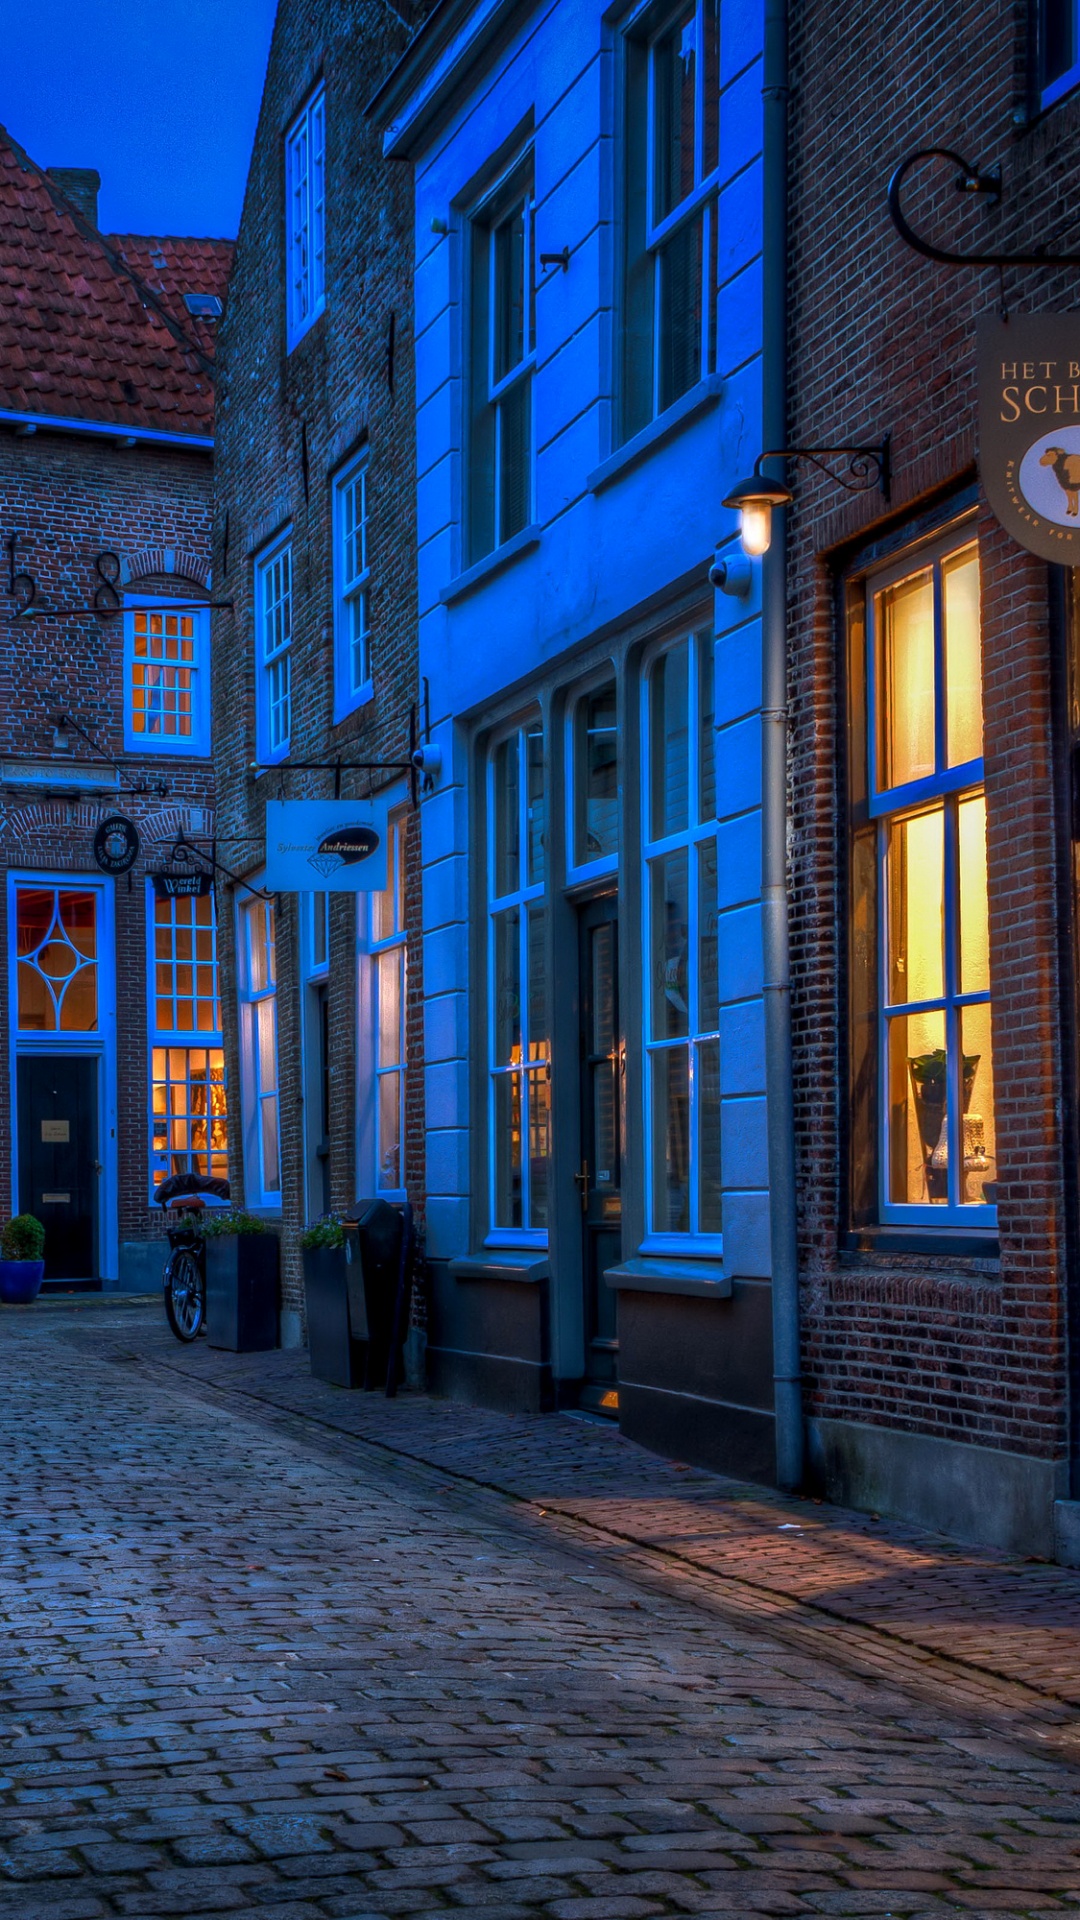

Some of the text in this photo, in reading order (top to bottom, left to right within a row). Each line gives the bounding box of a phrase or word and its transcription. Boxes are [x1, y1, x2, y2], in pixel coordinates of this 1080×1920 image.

[1001, 362, 1057, 380] HET
[1006, 460, 1039, 527] KNITWEAR
[1049, 529, 1073, 540] FOR
[319, 842, 369, 852] Andriessen
